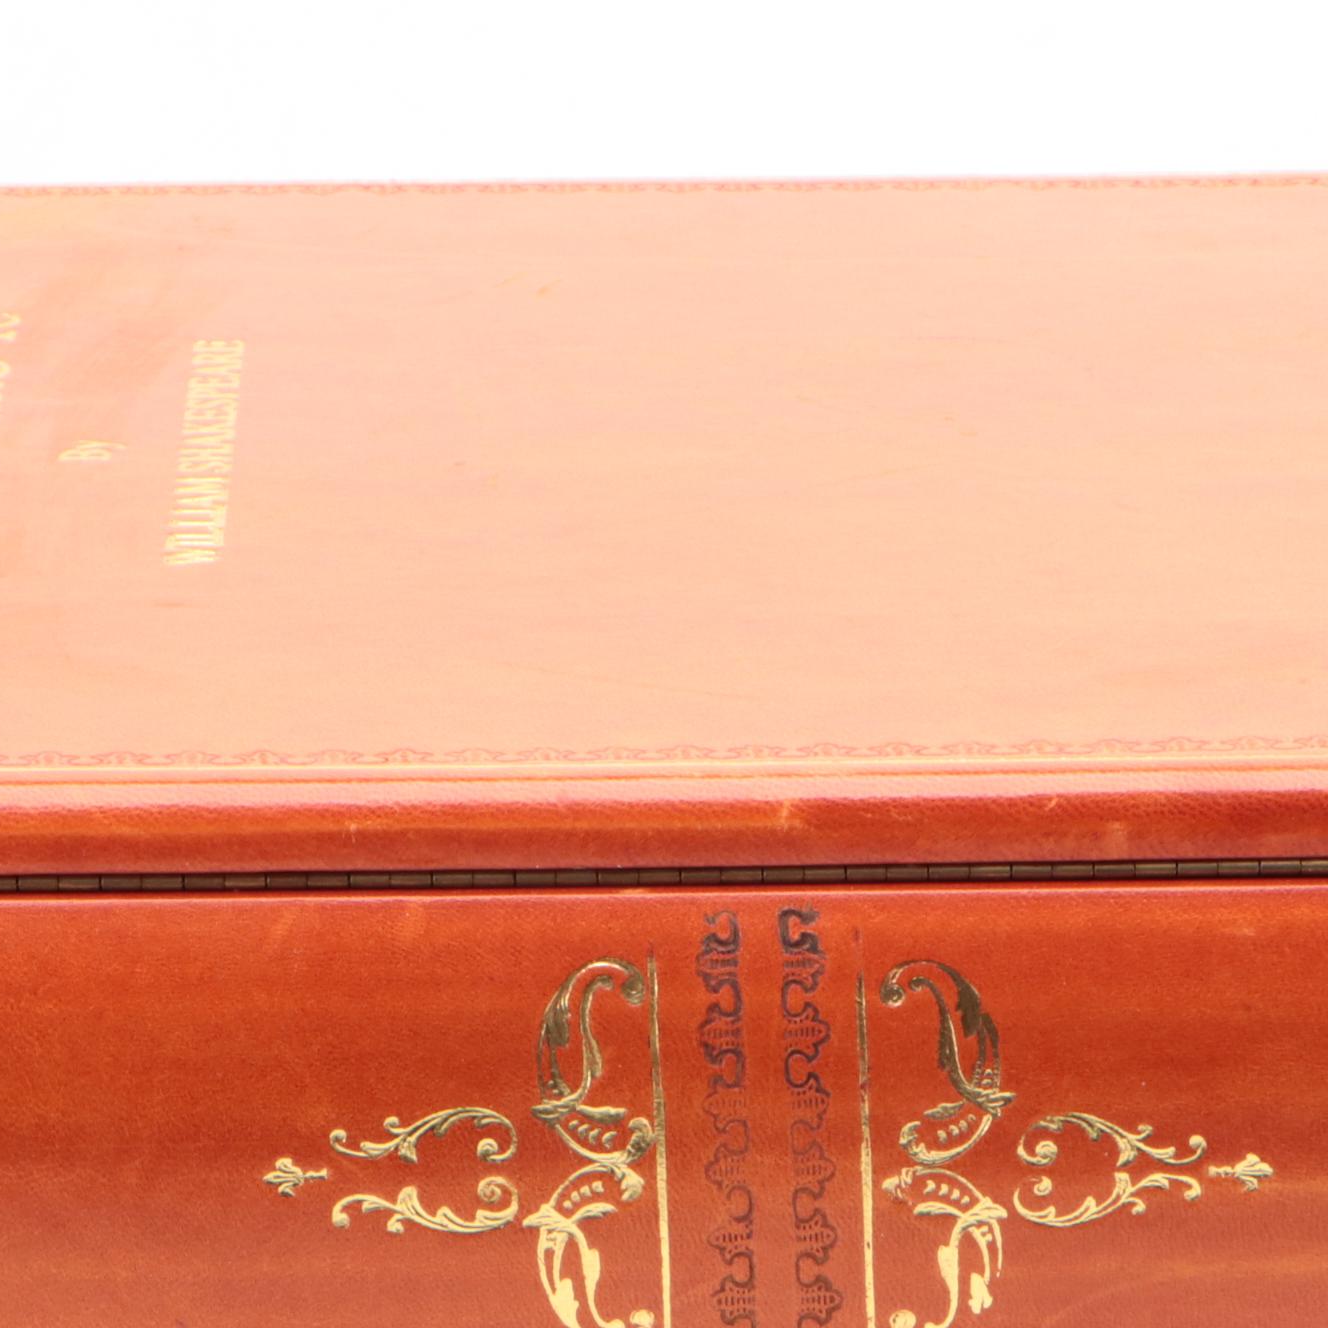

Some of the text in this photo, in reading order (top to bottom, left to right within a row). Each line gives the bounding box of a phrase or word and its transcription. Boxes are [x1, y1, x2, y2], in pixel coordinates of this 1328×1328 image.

[57, 439, 126, 462] By
[162, 338, 246, 566] WILLIAM SHAKESPEARE
